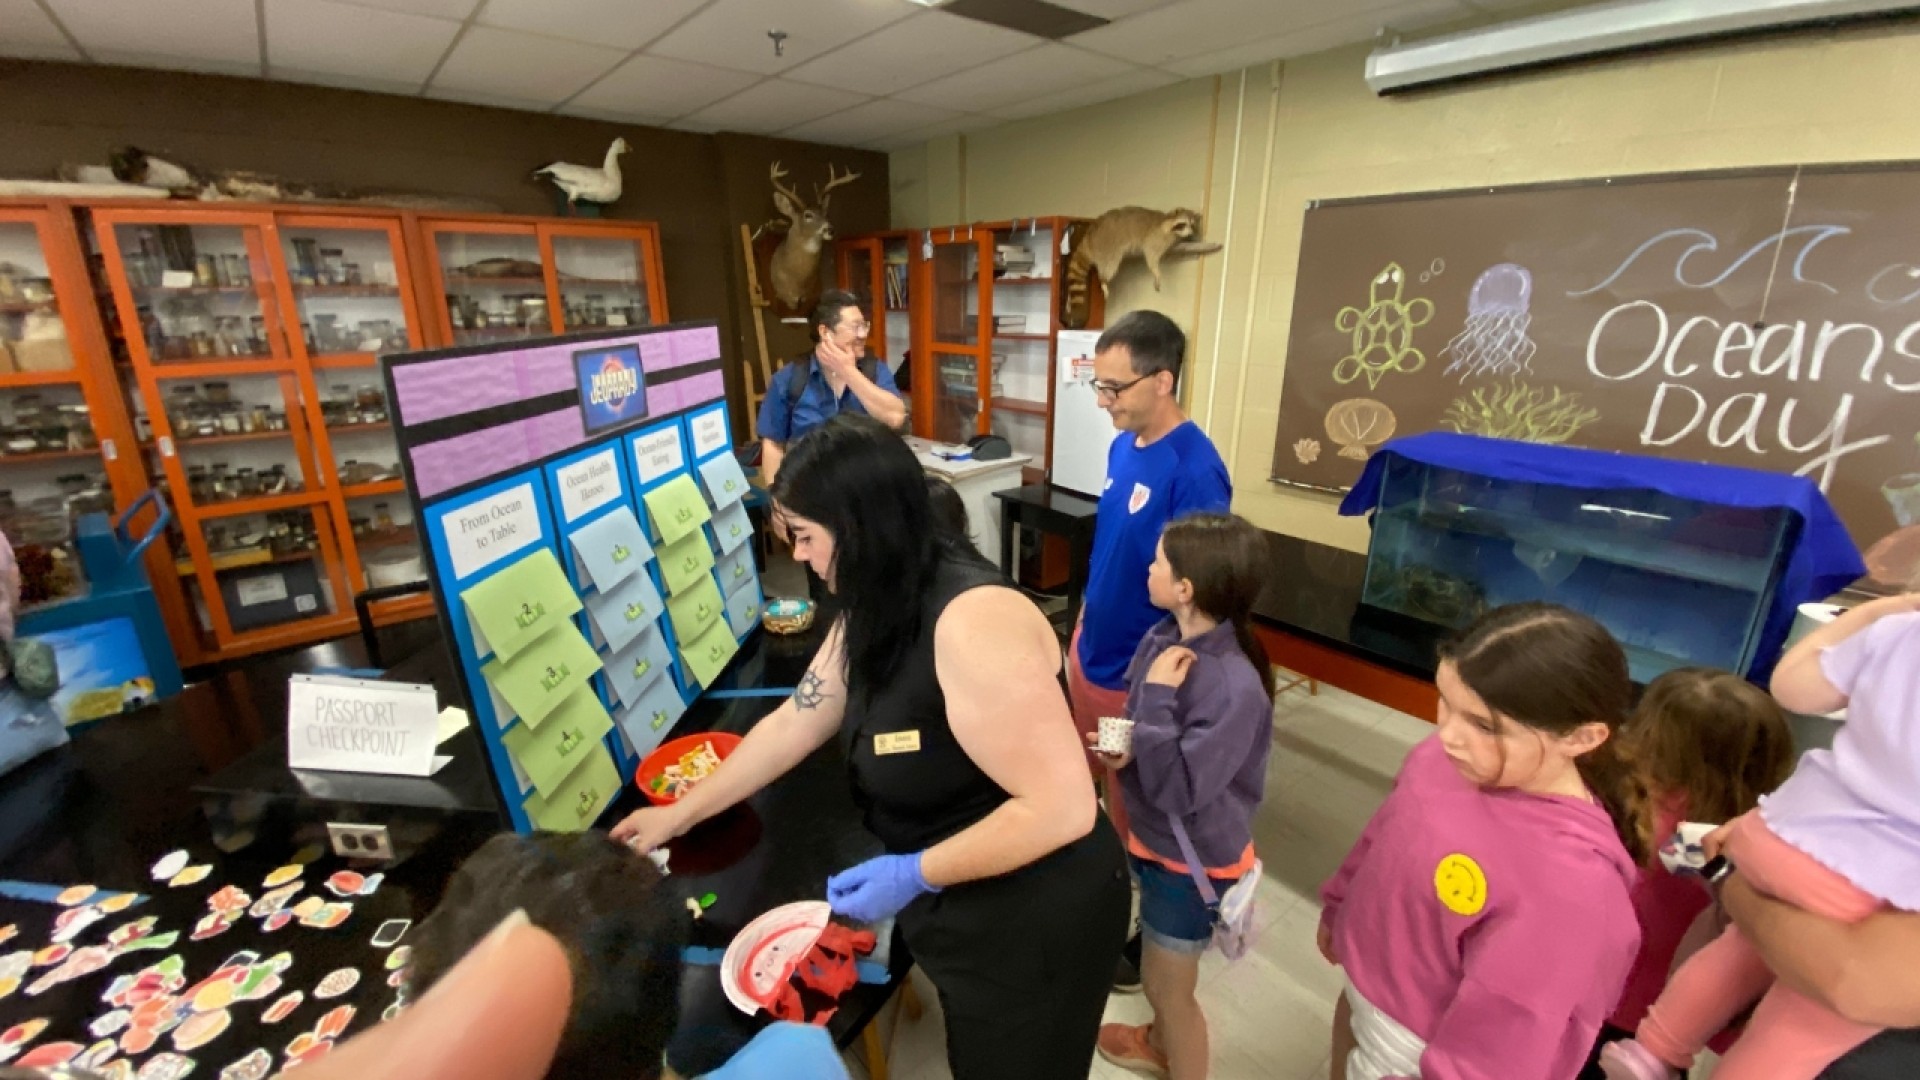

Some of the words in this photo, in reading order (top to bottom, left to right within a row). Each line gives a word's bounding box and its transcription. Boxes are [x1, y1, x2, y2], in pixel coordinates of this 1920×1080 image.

[1640, 382, 1891, 495] Day
[566, 467, 589, 488] Ocean
[589, 459, 612, 479] Health
[580, 483, 605, 501] Heroes
[460, 513, 490, 534] From
[490, 499, 523, 520] Ocean
[476, 536, 489, 549] to
[489, 521, 517, 542] Table
[315, 696, 398, 727] PASSPORT
[306, 725, 411, 756] CHECKPOINT
